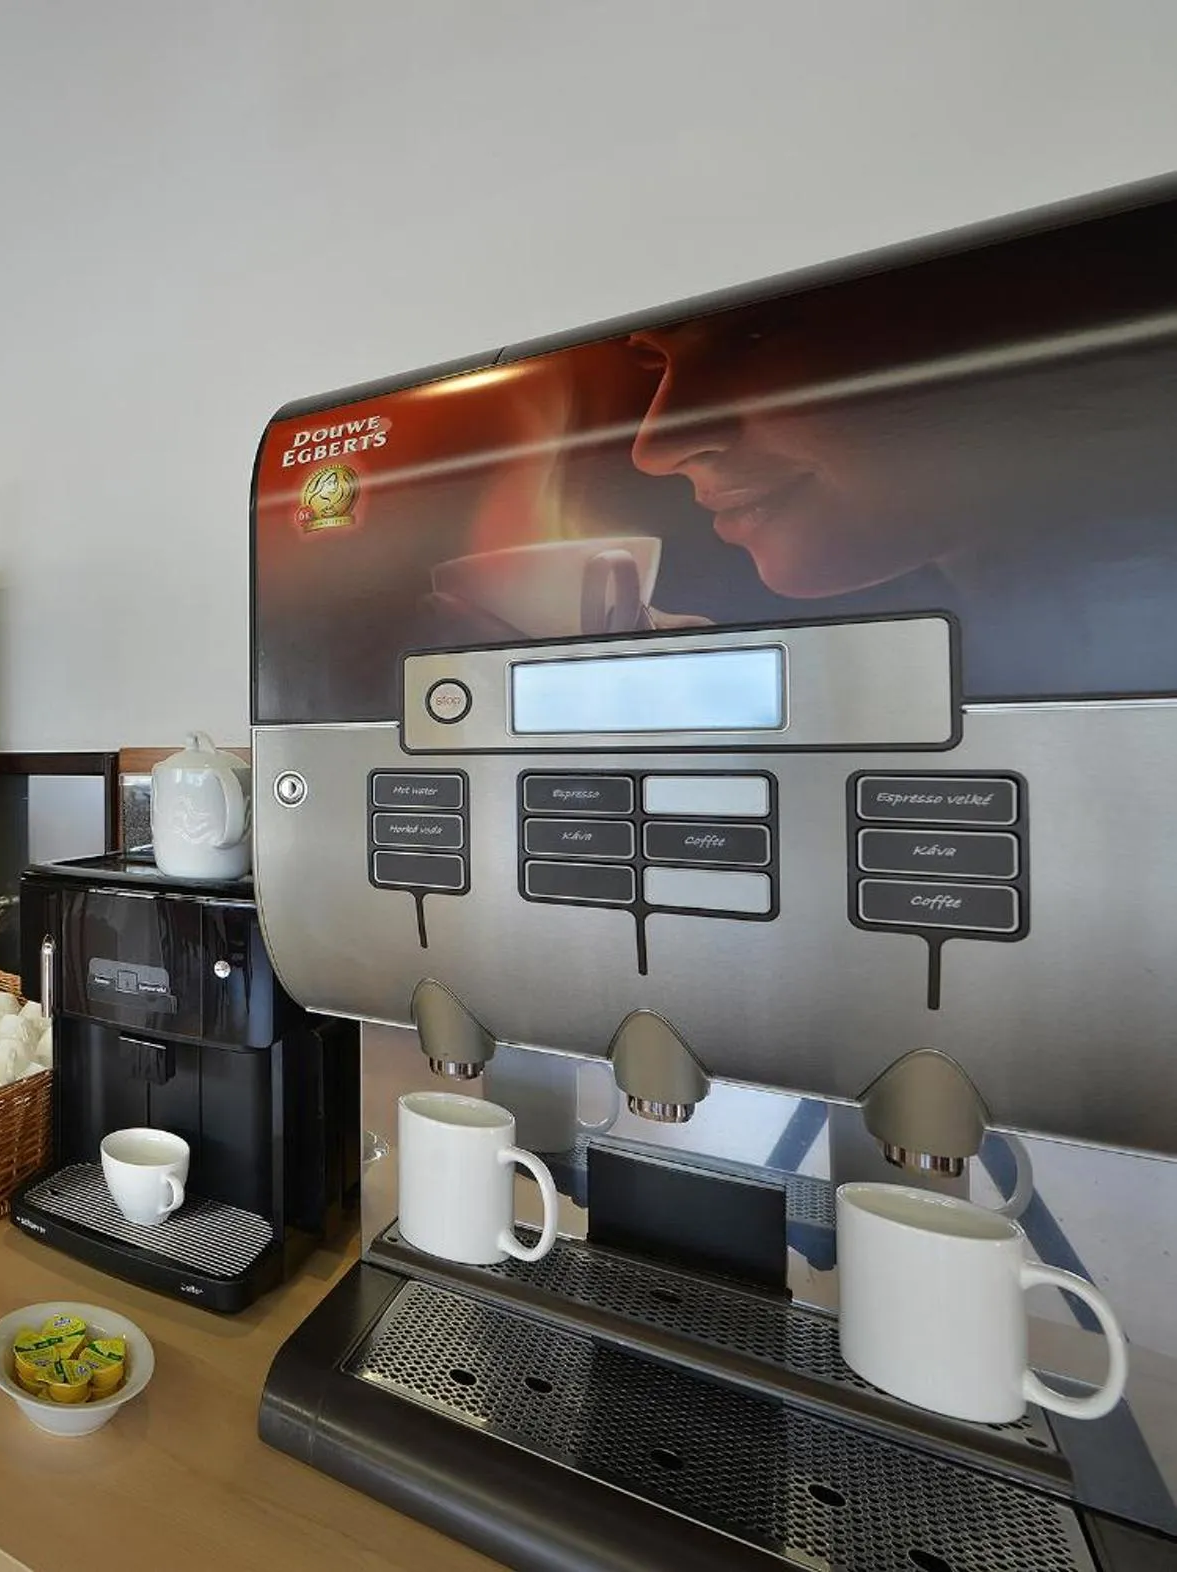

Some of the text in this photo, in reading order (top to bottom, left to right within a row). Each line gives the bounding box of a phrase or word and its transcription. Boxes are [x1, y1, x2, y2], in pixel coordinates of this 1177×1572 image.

[293, 415, 381, 448] DOUWE
[281, 431, 388, 467] EGBERTS
[875, 792, 943, 807] Espresso
[683, 834, 726, 849] Coffee
[910, 894, 963, 911] Coffee
